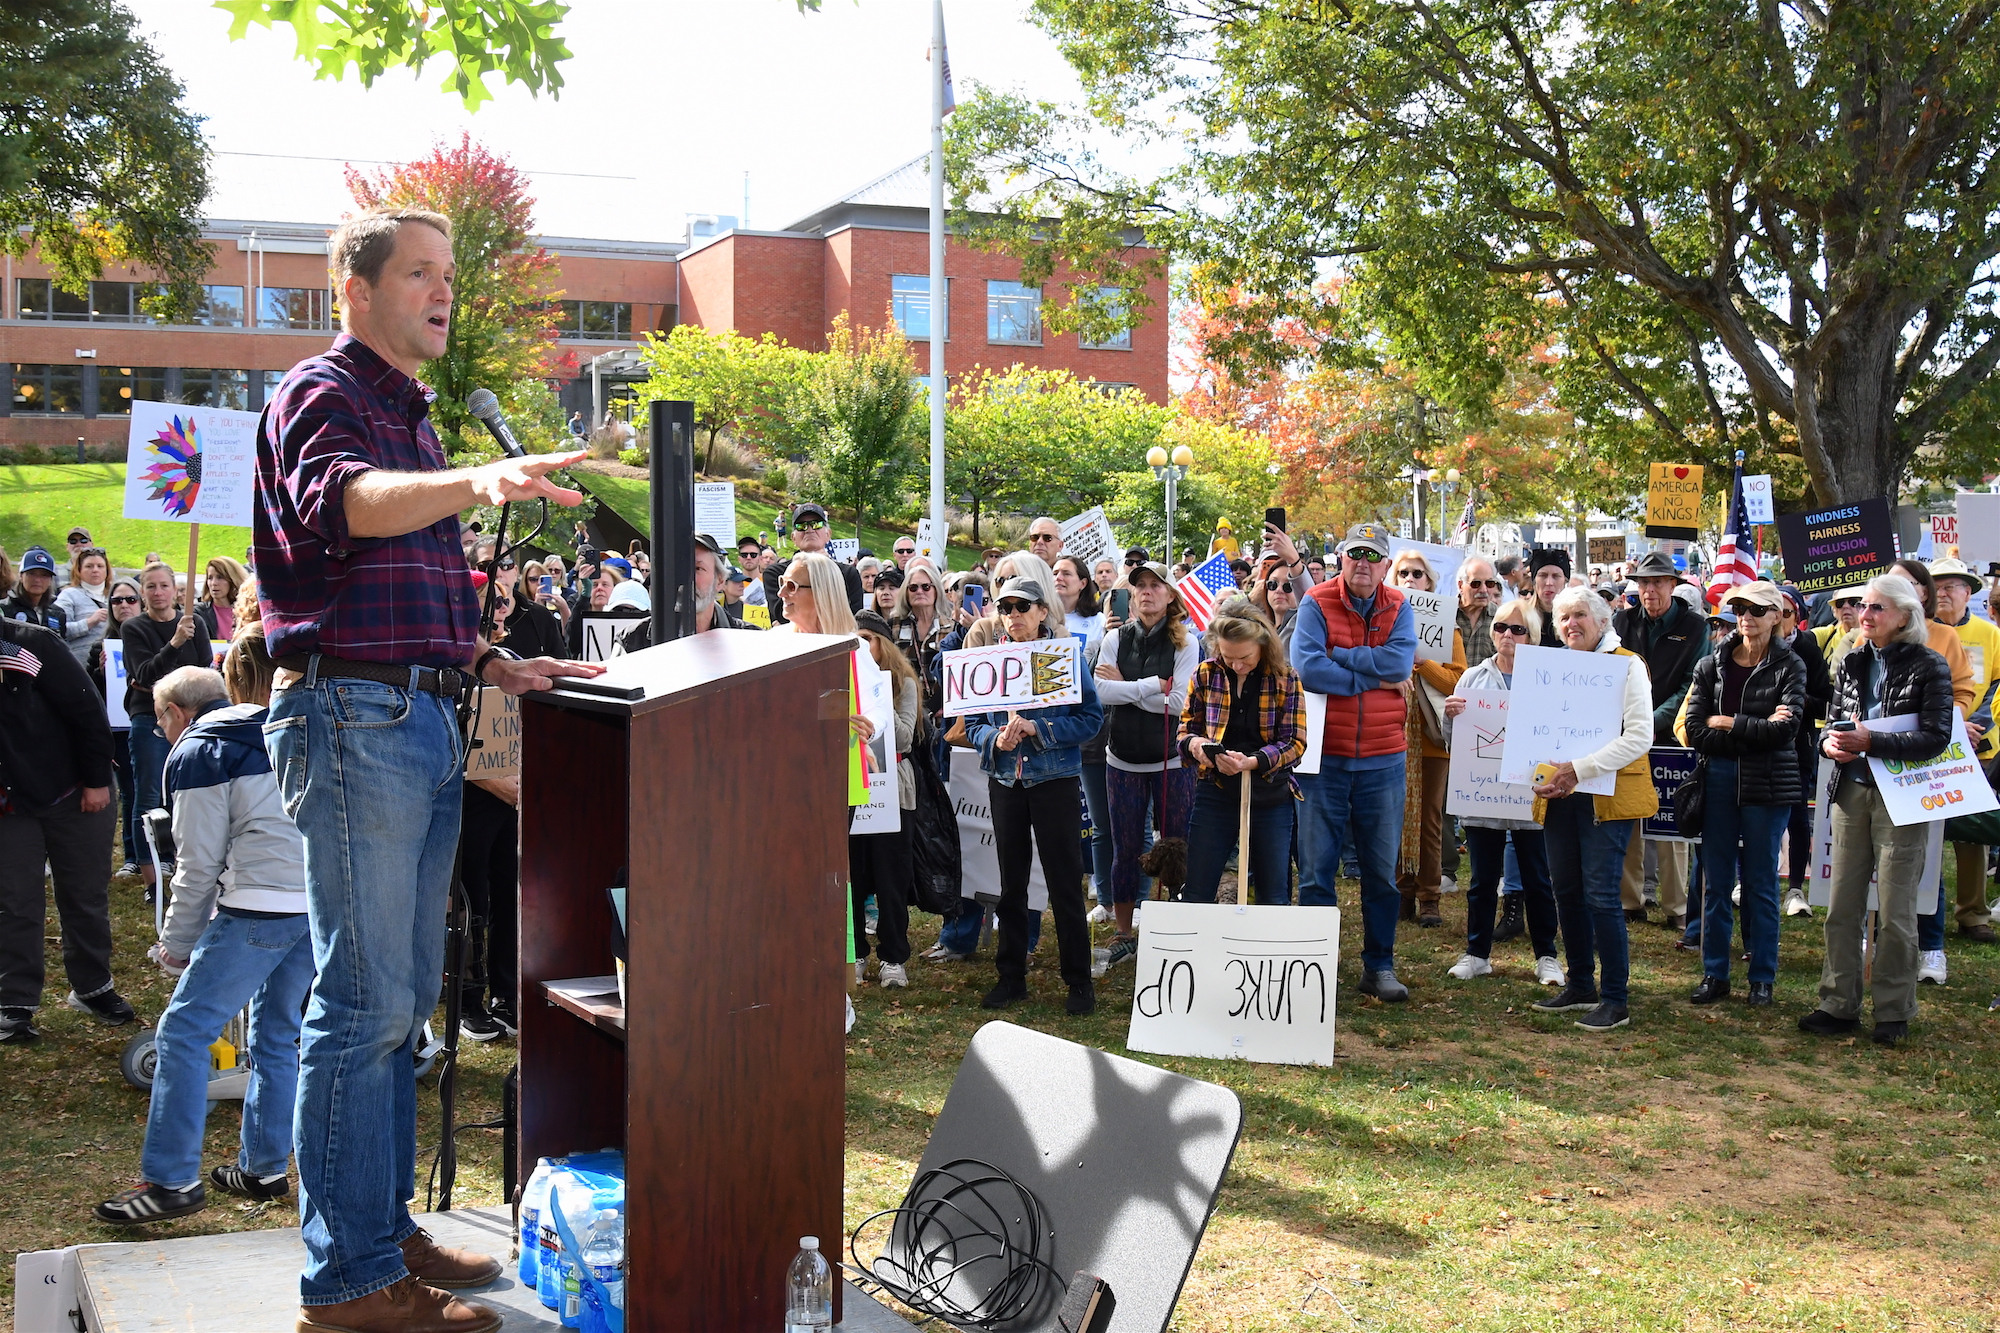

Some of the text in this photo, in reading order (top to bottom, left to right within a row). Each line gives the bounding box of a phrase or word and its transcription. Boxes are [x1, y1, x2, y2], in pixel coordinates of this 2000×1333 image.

[208, 416, 258, 429] IF YOU THINK
[209, 428, 221, 436] YOU
[1662, 466, 1668, 478] I
[1651, 481, 1699, 493] AMERICA
[1750, 480, 1766, 491] NO
[1664, 497, 1683, 506] NO
[1652, 507, 1699, 522] KINGS!
[1805, 506, 1860, 526] KINDNESS
[1809, 522, 1861, 540] FAIRNESS
[1590, 540, 1624, 548] DEMOCRACY
[1603, 546, 1611, 554] IN
[1808, 538, 1868, 556] INCLUSION
[1590, 552, 1625, 563] PERIL
[1804, 552, 1877, 574] HOPE & LOVE
[1792, 576, 1825, 592] MAKE
[1828, 573, 1842, 586] US
[1410, 594, 1442, 612] LOVE
[1562, 672, 1613, 688] KINGS
[1478, 700, 1492, 710] No
[1534, 726, 1602, 738] NO TRUMP
[1894, 765, 1974, 787] THEIR DEMOCRACY
[1455, 790, 1470, 801] The
[1921, 790, 1964, 810] OURS
[1653, 812, 1674, 822] ARE
[1137, 959, 1324, 1024] WAKE UP
